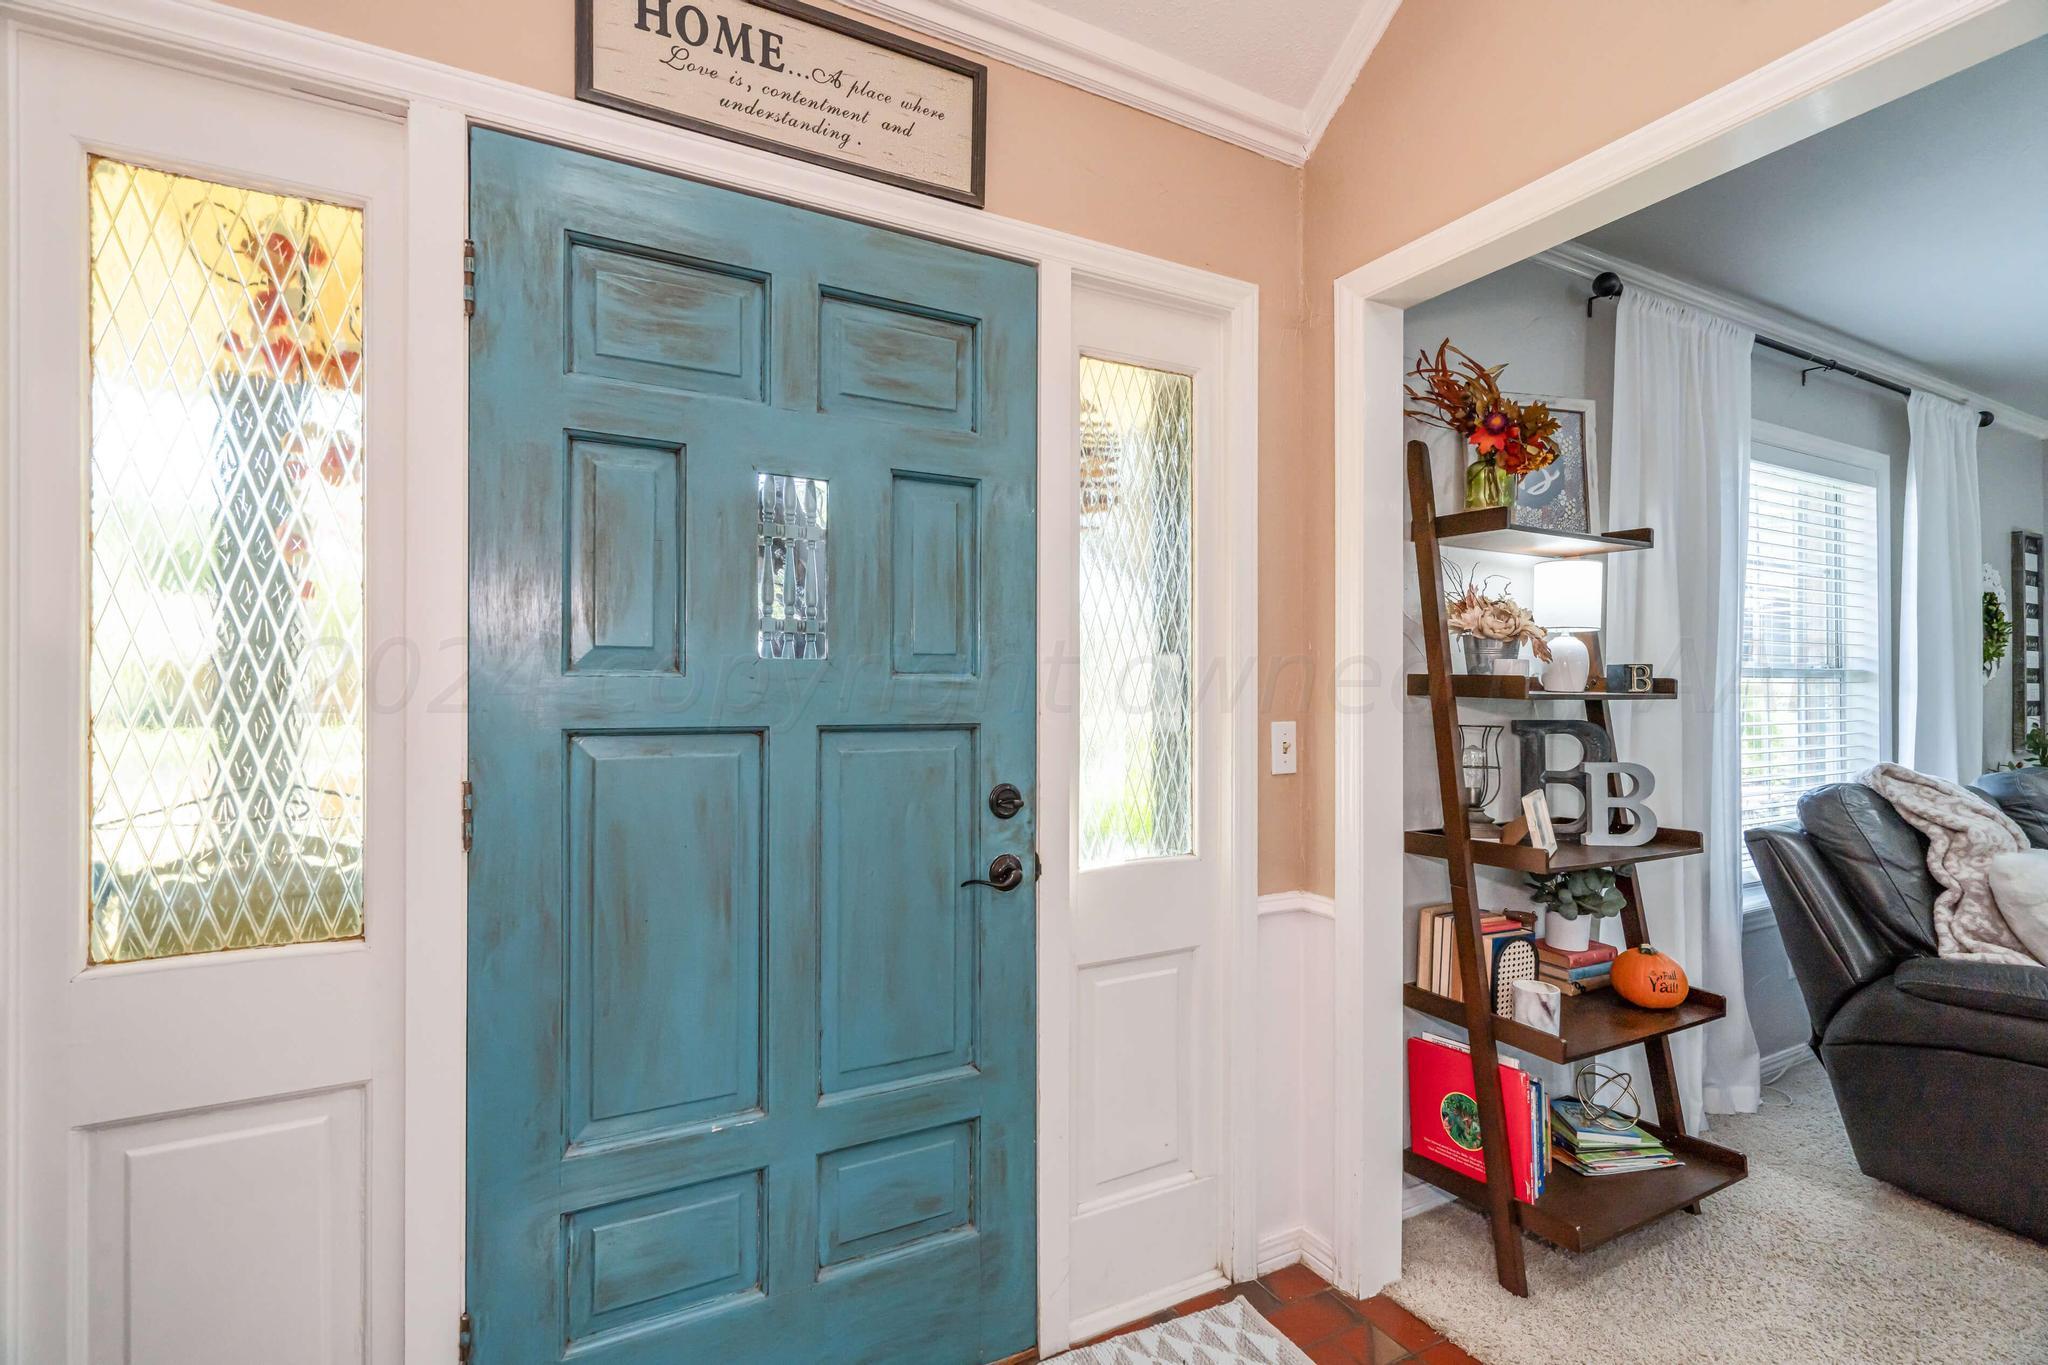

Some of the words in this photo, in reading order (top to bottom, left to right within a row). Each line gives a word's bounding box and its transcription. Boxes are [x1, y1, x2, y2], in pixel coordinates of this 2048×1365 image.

[658, 44, 719, 79] Love
[728, 70, 753, 93] is,
[761, 85, 871, 124] contentment
[880, 120, 916, 138] and
[846, 80, 893, 104] place
[900, 97, 946, 121] where
[1627, 664, 1651, 693] B
[1580, 761, 1658, 847] B
